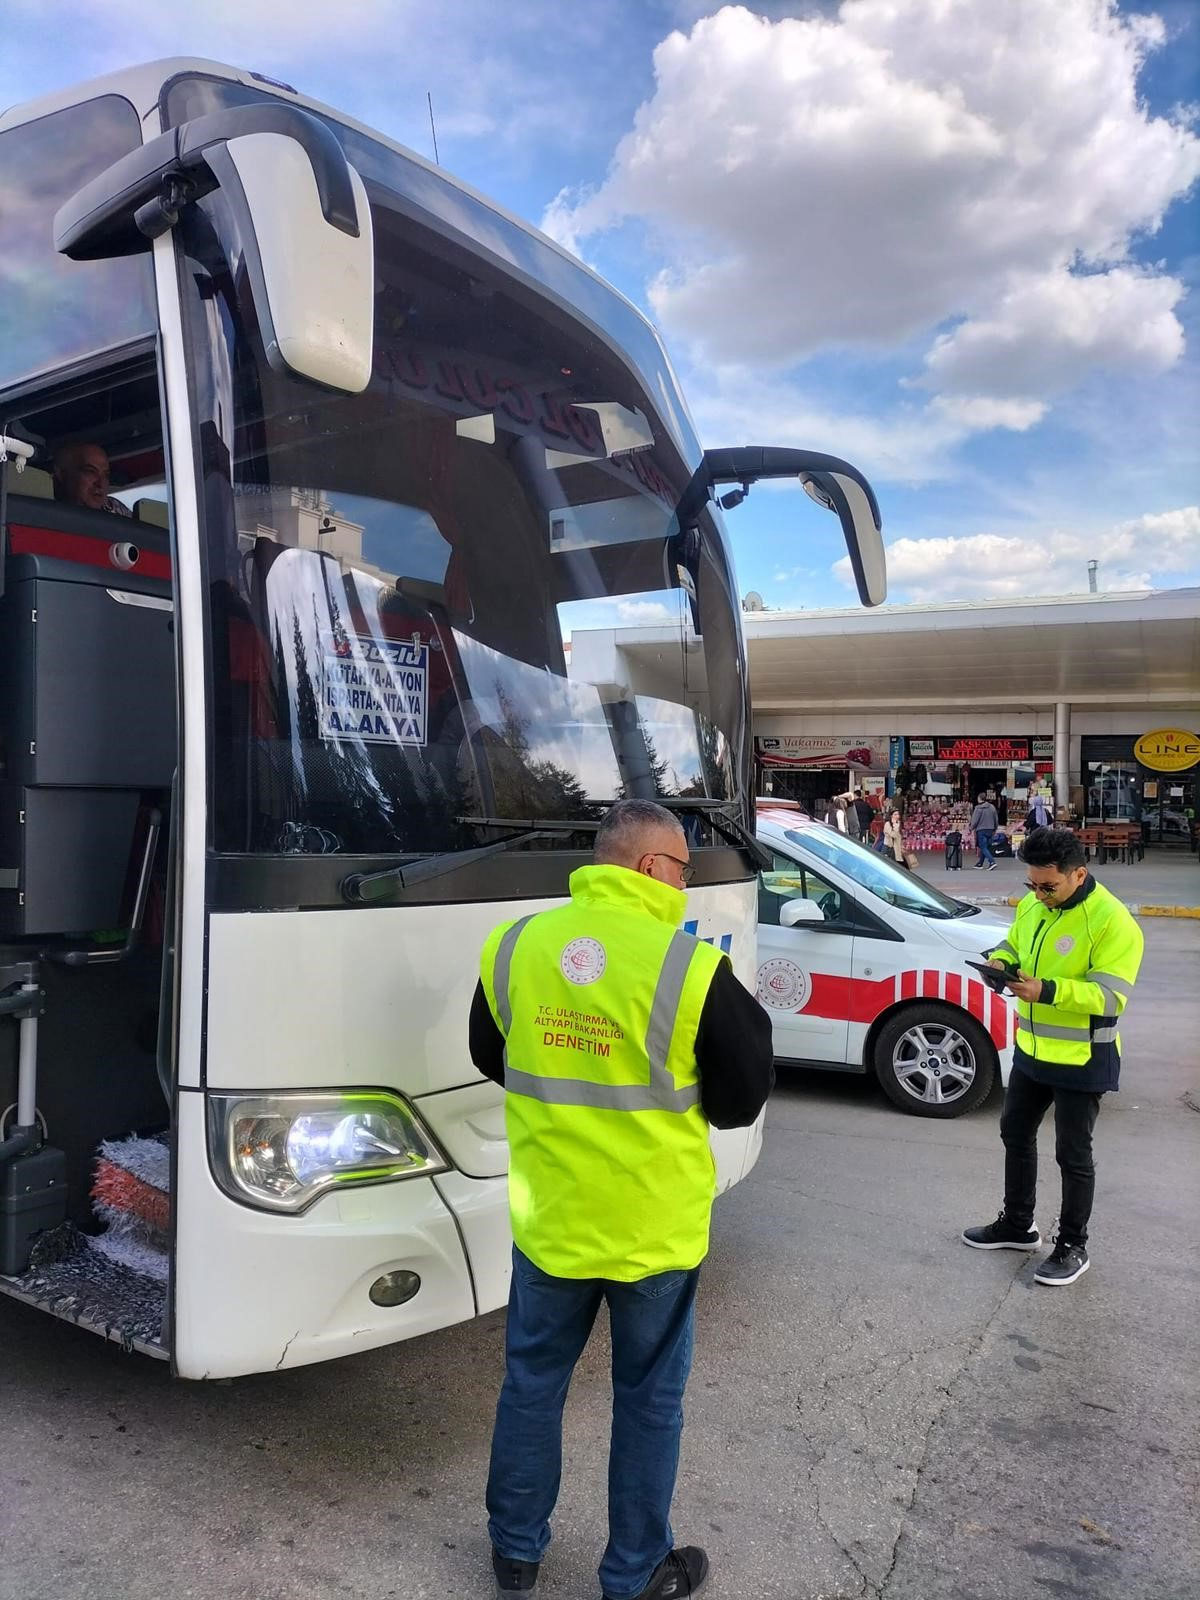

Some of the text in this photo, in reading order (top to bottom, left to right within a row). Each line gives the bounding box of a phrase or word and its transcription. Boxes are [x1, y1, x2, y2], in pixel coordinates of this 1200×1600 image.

[329, 711, 421, 737] ALANYA
[953, 740, 1012, 749] AKSESUAR
[1139, 744, 1200, 753] LINE
[538, 1006, 554, 1016] T.C.
[556, 1007, 608, 1026] ULAŞTIRMA
[534, 1017, 624, 1040] ALTYAPI BAKANLIĞI
[543, 1032, 610, 1057] DENETİM
